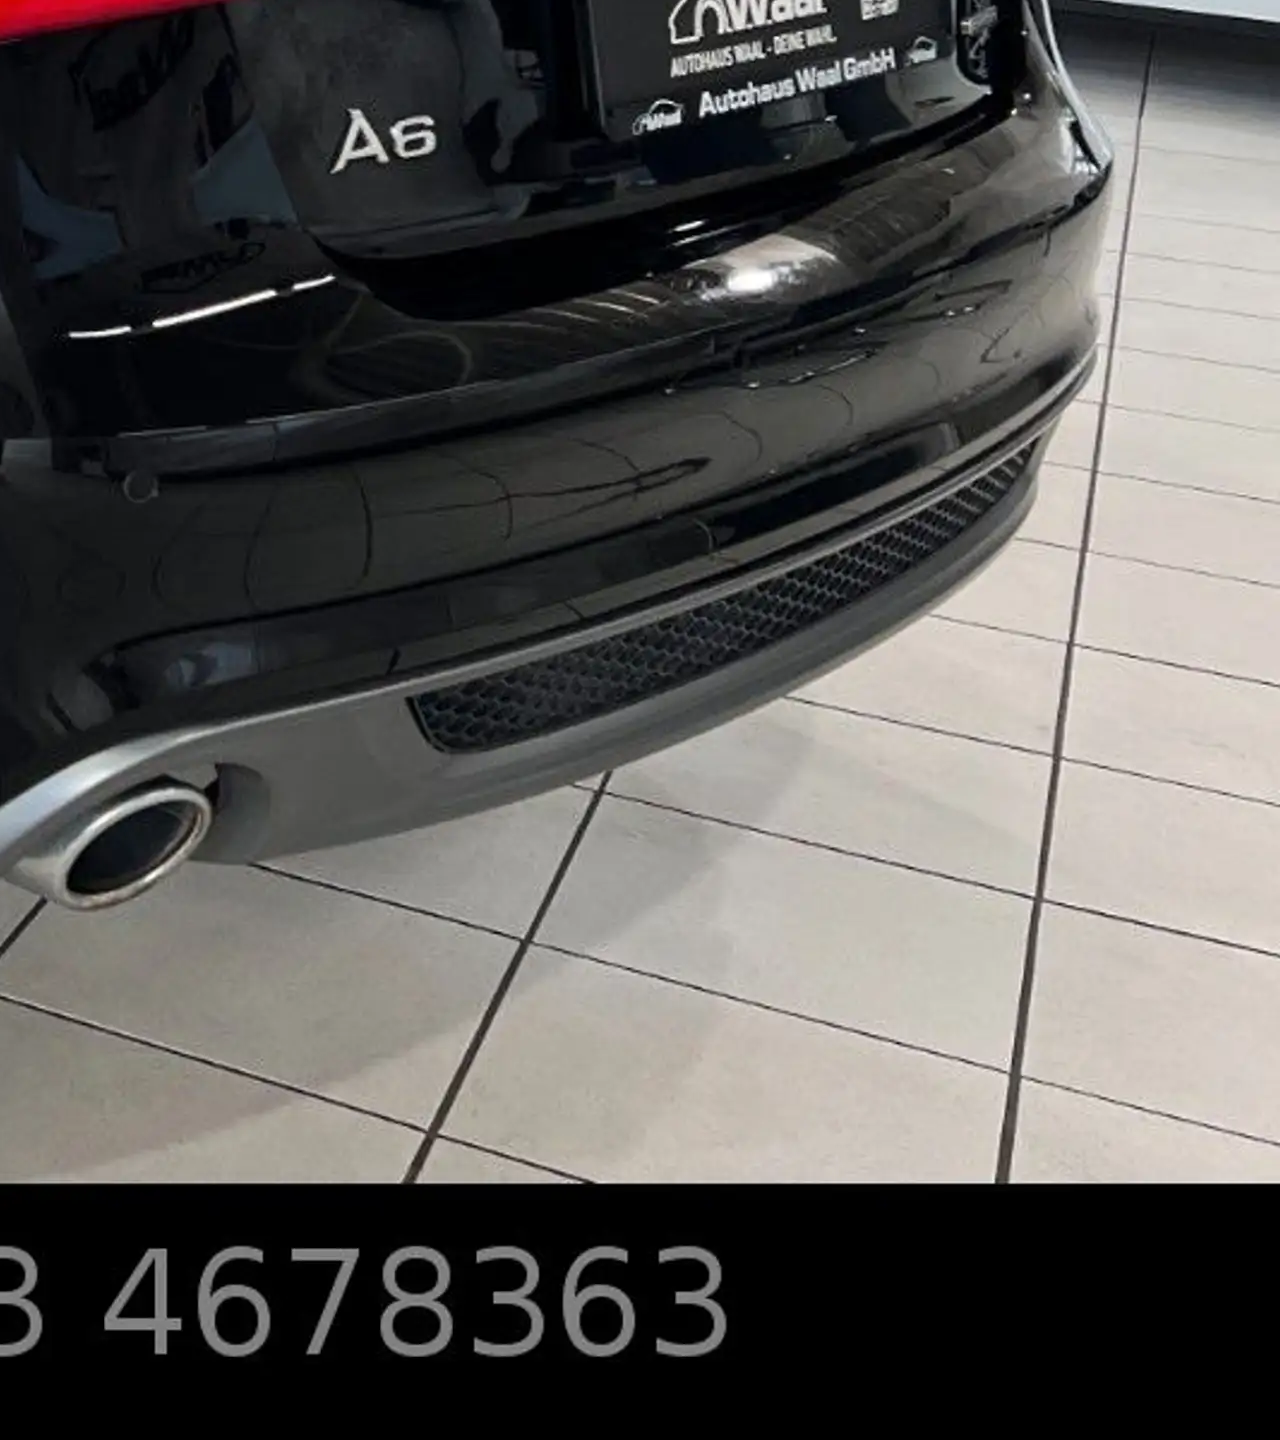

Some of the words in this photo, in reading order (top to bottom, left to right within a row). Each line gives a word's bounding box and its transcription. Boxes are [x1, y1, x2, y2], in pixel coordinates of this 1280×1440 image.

[670, 45, 734, 77] AUTOHAUS
[698, 81, 797, 118] Autohaus
[794, 60, 842, 93] Waal
[842, 46, 897, 82] GmbH
[329, 108, 437, 175] A6
